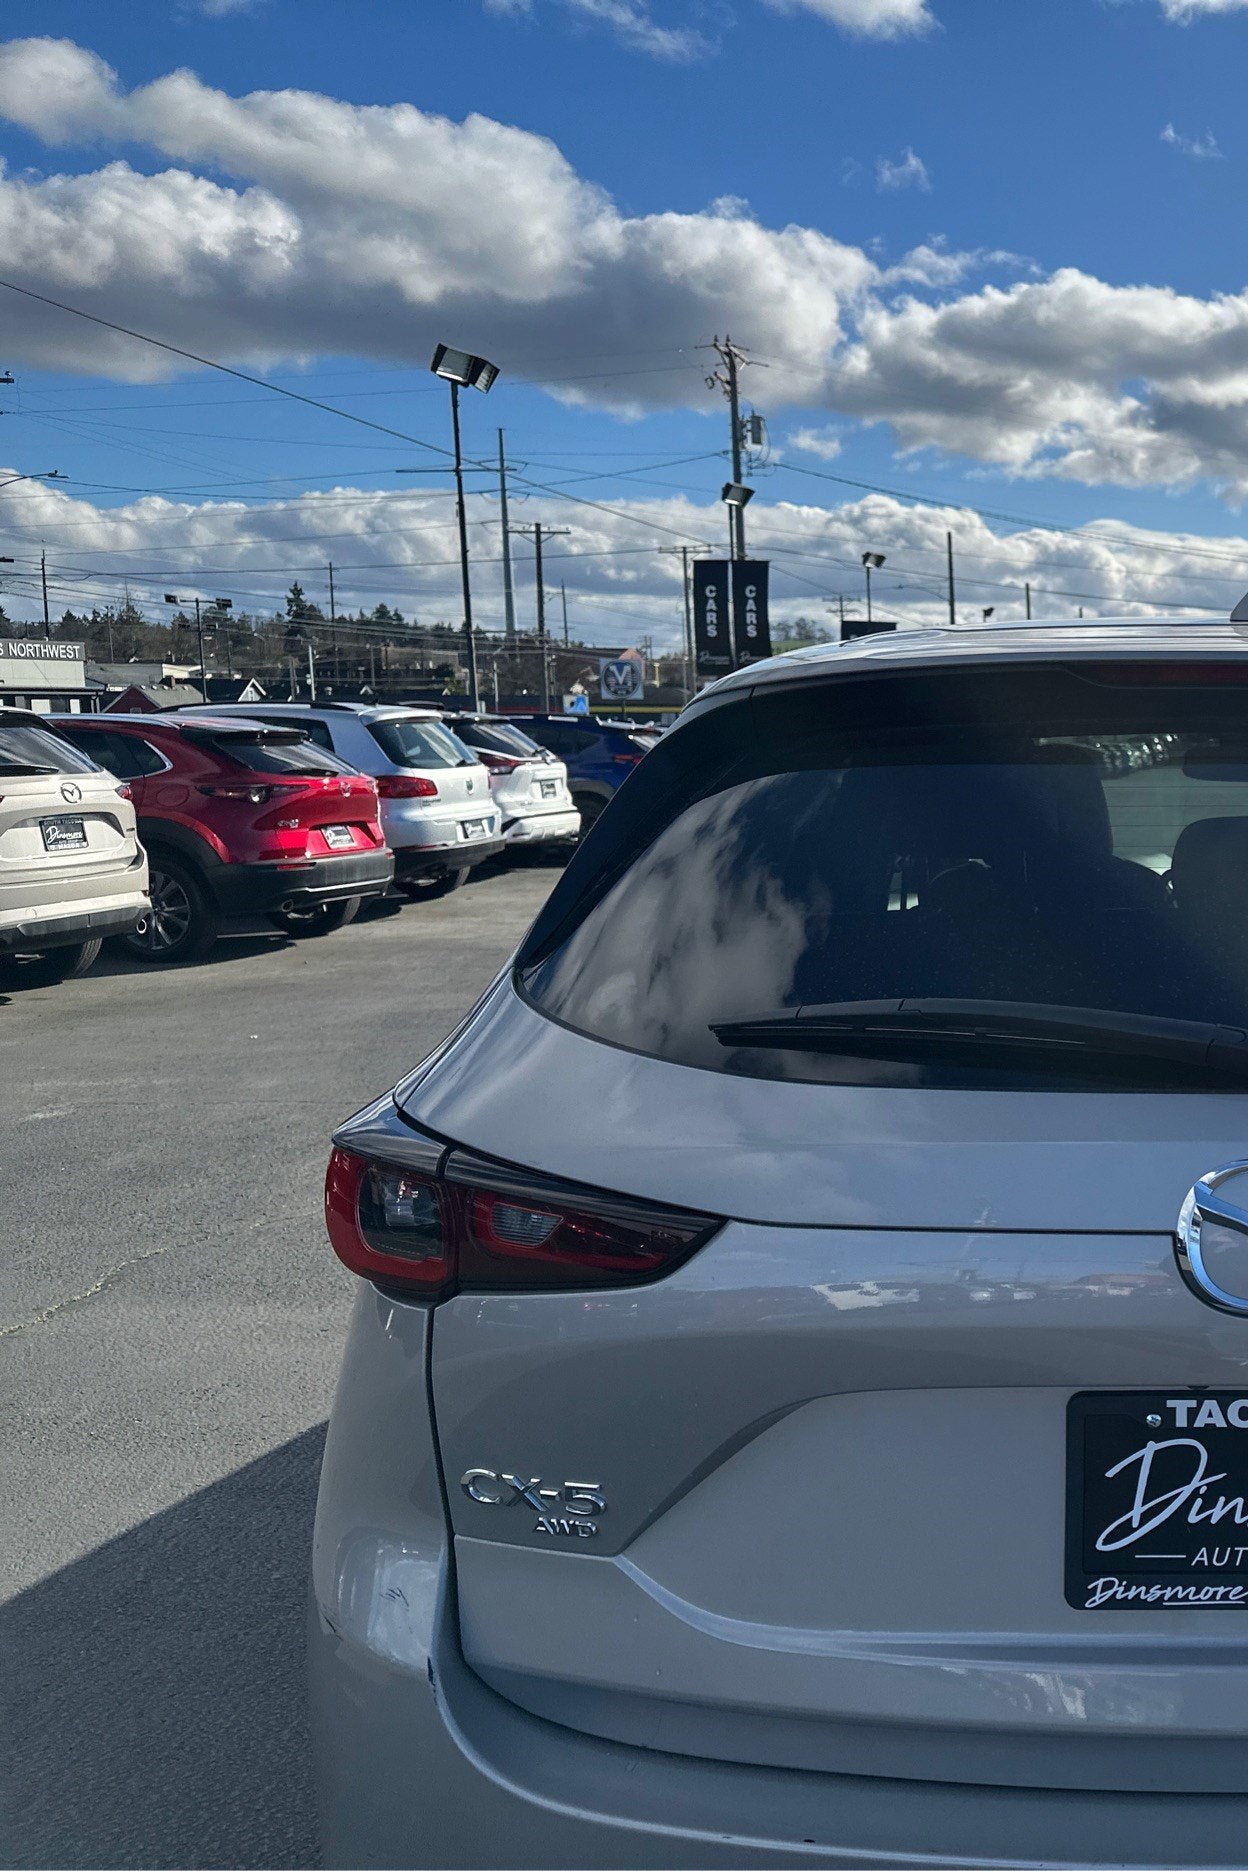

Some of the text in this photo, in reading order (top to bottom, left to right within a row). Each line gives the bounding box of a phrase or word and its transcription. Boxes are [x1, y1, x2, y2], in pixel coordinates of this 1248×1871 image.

[705, 584, 718, 638] CARS
[745, 584, 758, 638] CARS
[8, 642, 80, 659] NORTHWEST
[460, 1468, 608, 1516] CX-5
[533, 1516, 598, 1538] AWD
